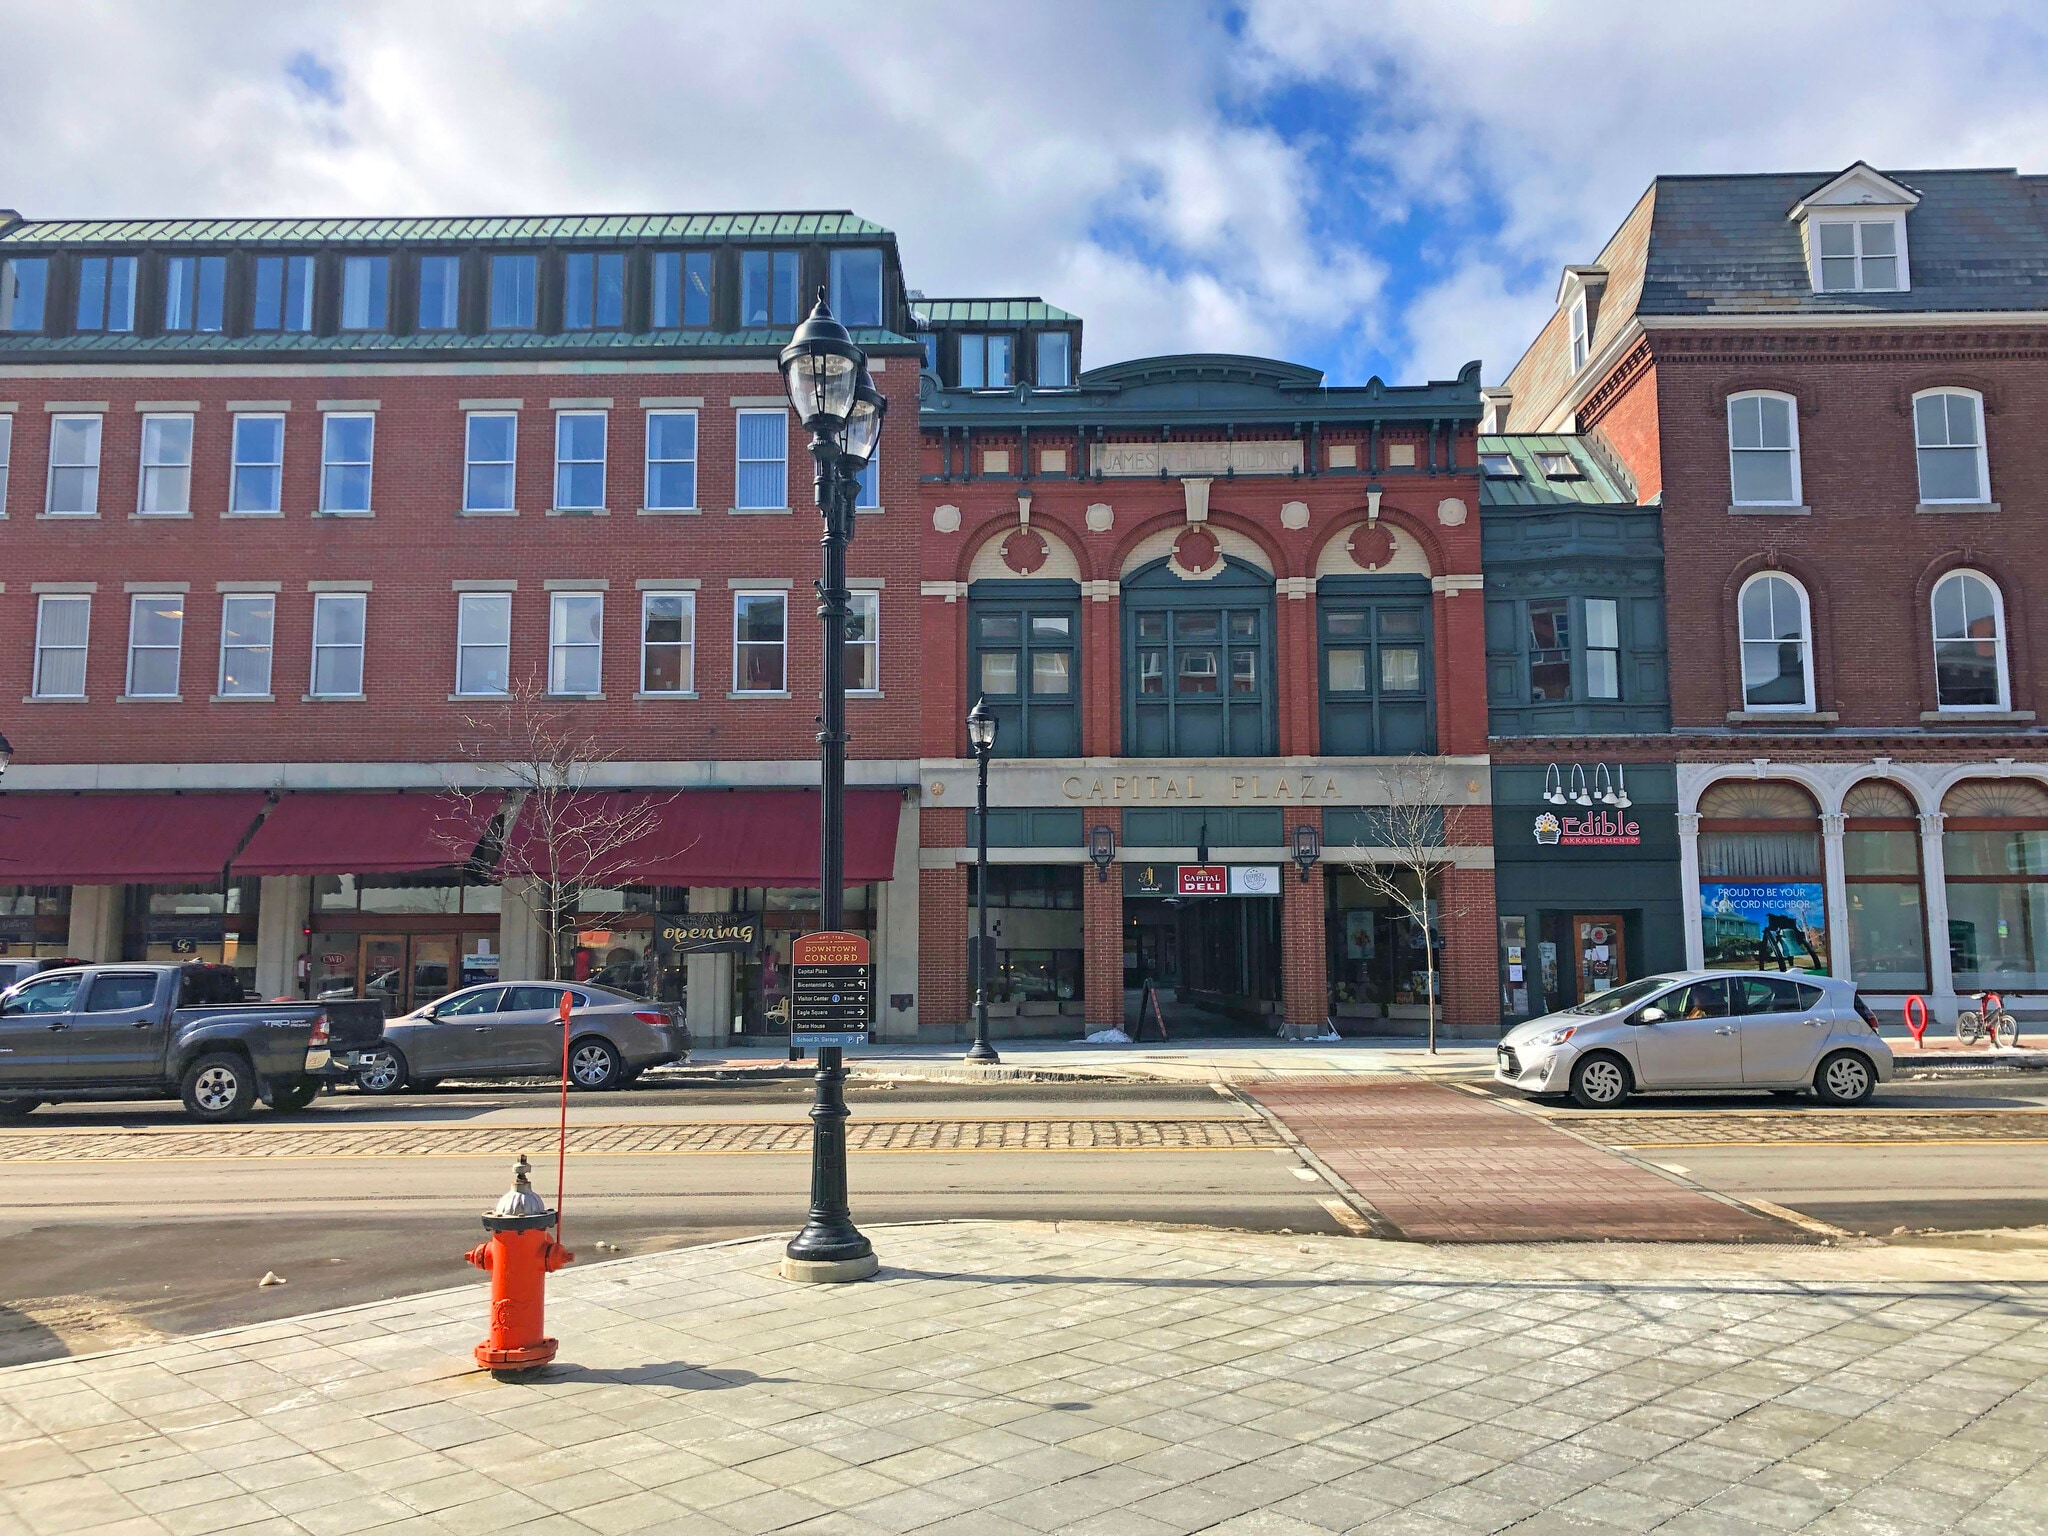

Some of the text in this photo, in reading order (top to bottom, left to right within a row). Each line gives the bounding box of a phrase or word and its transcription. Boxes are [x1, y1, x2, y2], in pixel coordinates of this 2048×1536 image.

[1104, 452, 1155, 471] JAMES
[1178, 451, 1212, 470] HILL
[1062, 775, 1342, 799] CAPITAL PLAZA
[1562, 810, 1640, 836] Edible
[1185, 883, 1220, 891] DELI
[1718, 888, 1806, 897] PROUD TO BE YOUR
[1713, 900, 1760, 909] CONCORD
[673, 914, 738, 926] GRAND
[662, 925, 754, 943] opening
[804, 954, 858, 962] CONCORD
[262, 1020, 290, 1028] TRD
